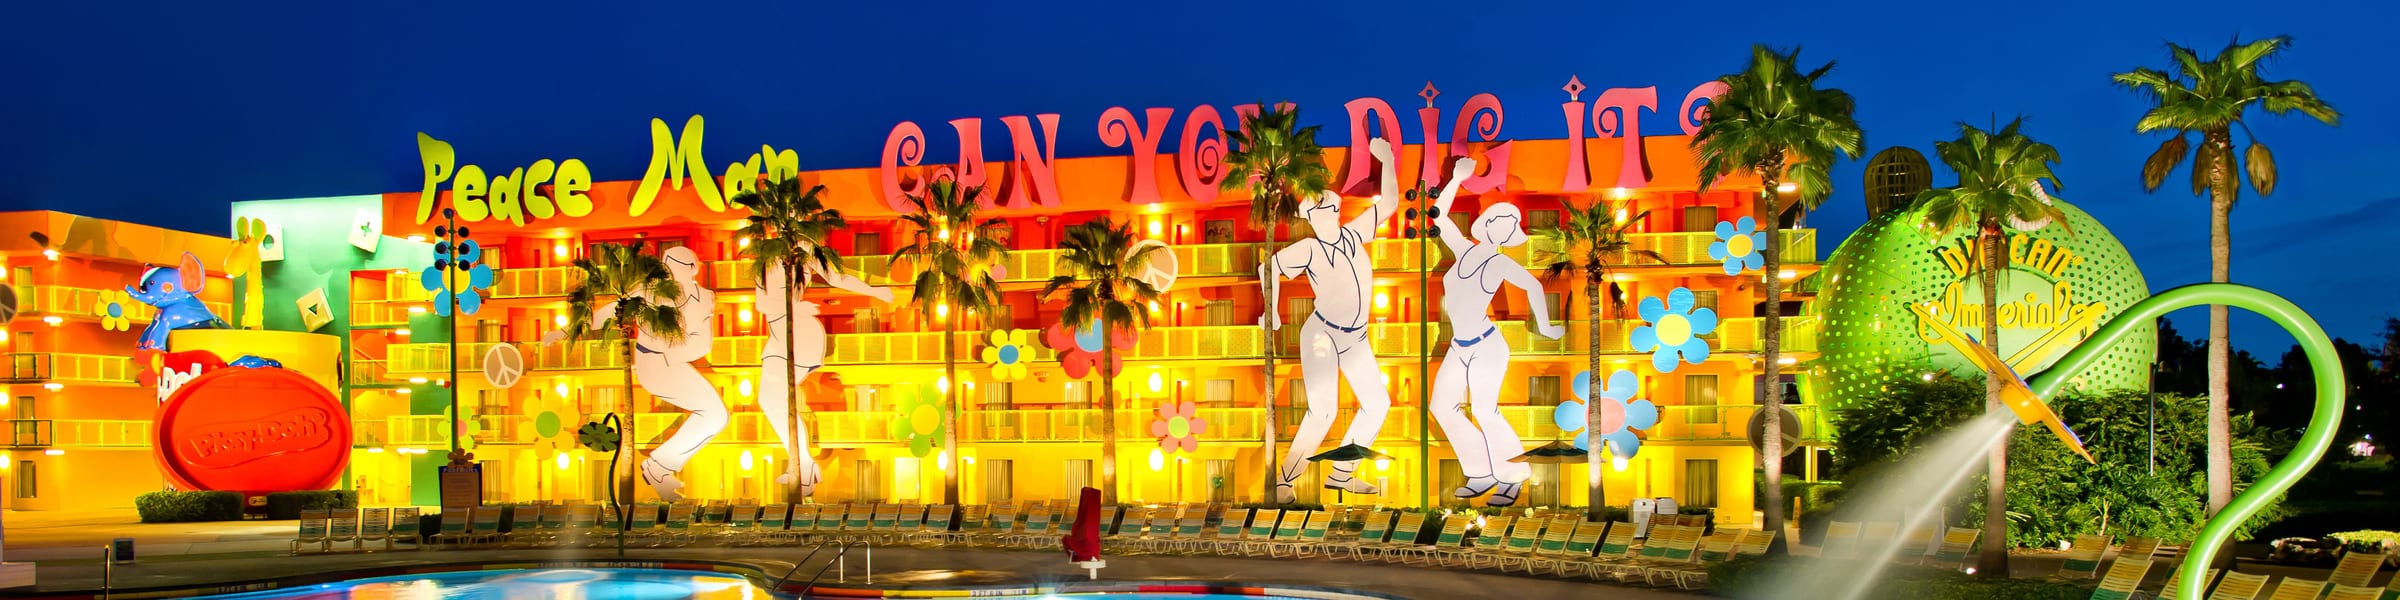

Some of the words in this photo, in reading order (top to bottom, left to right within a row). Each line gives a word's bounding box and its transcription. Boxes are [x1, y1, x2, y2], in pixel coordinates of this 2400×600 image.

[416, 131, 593, 227] Peace
[629, 114, 799, 216] Man
[880, 113, 1061, 213] CAN
[1920, 280, 2088, 346] Imerial
